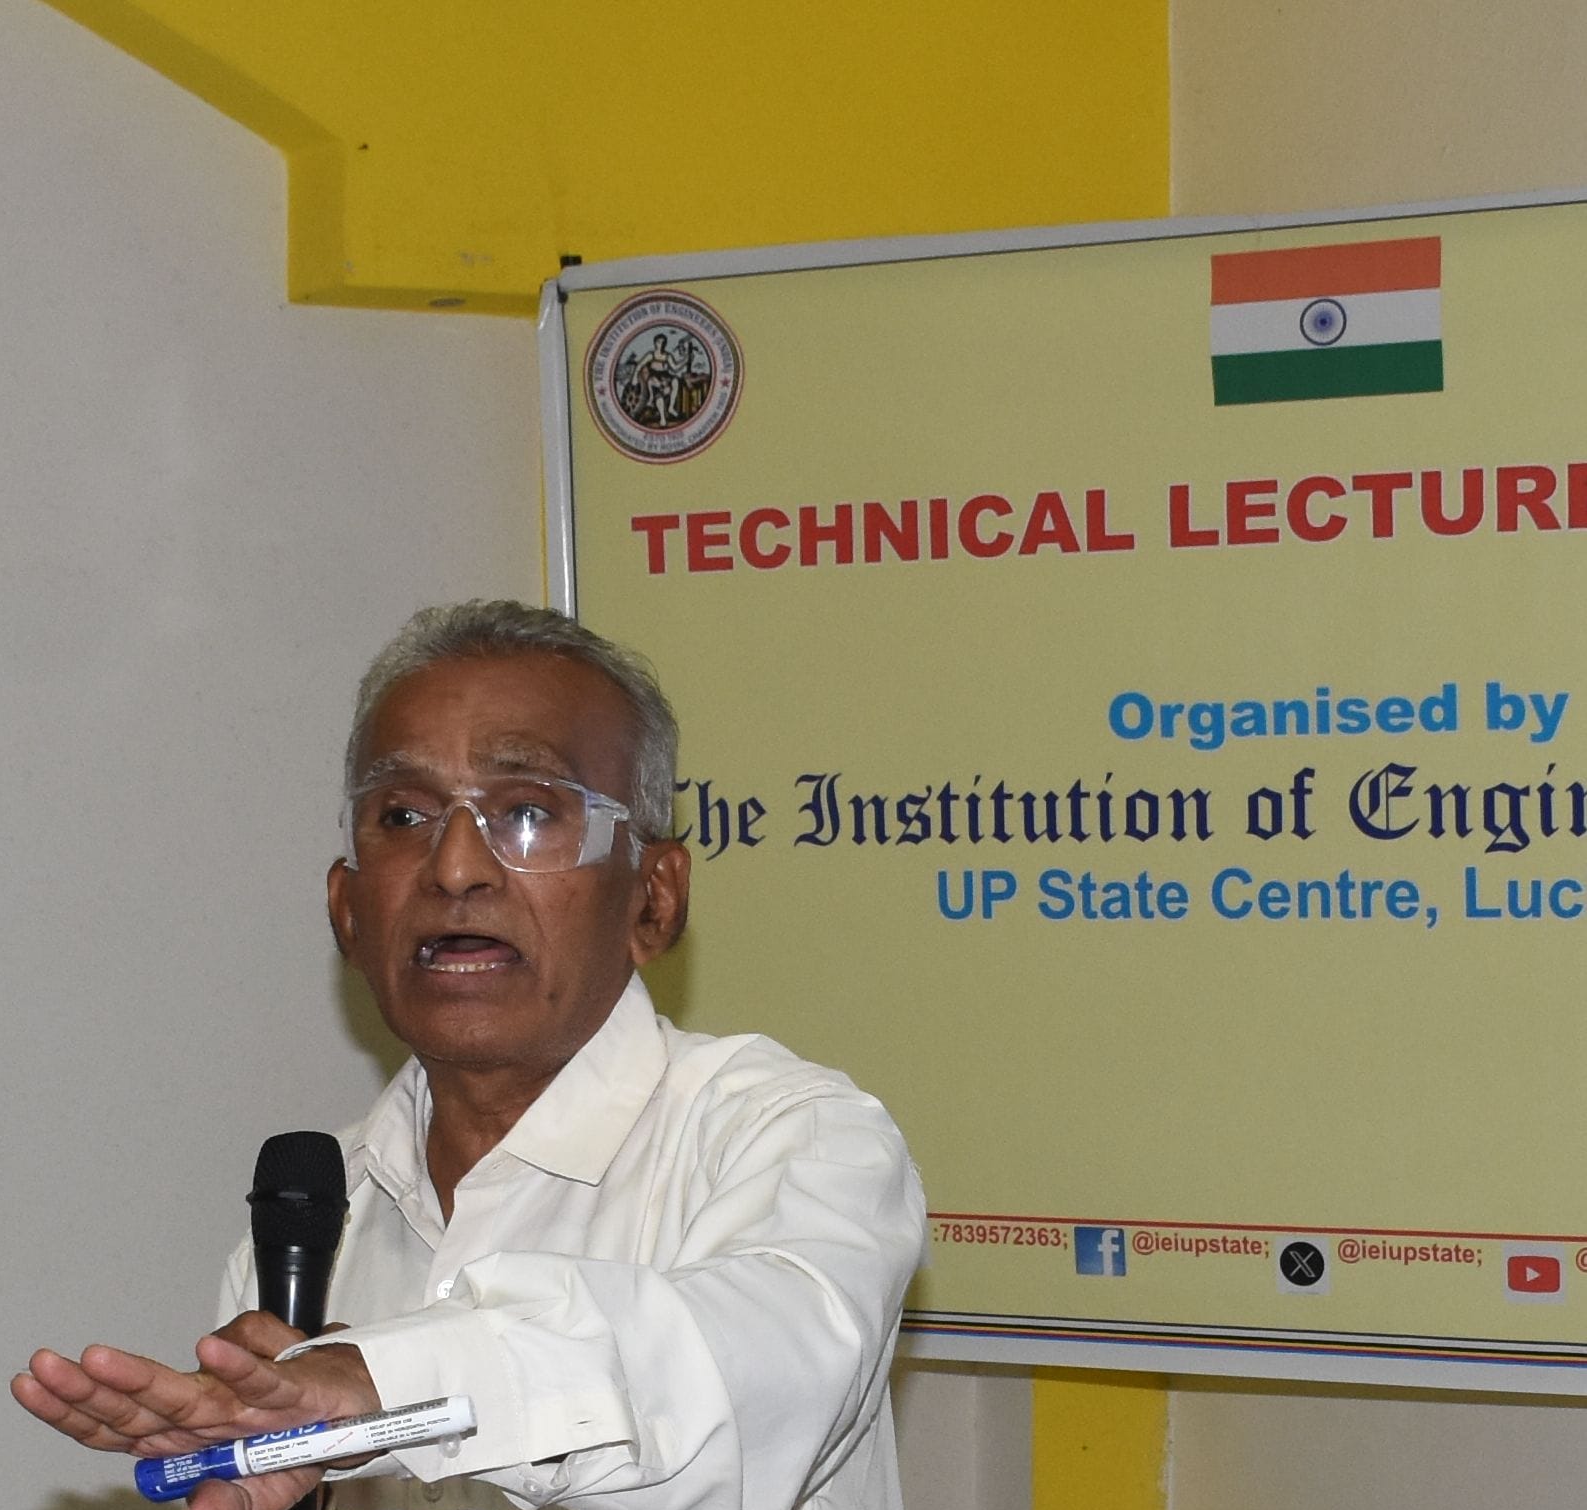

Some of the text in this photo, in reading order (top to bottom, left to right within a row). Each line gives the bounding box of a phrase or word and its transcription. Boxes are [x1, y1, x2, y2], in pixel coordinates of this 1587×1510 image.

[631, 487, 1136, 575] TECHNICAL
[1108, 680, 1571, 752] Organised by
[794, 772, 1214, 849] Institution
[1246, 765, 1317, 841] of
[937, 867, 1017, 921] UP
[1038, 867, 1191, 921] State
[1210, 866, 1440, 930] Centre,
[1131, 1229, 1270, 1259] @ieiupstate;
[1336, 1238, 1484, 1268] @ieiupstate;
